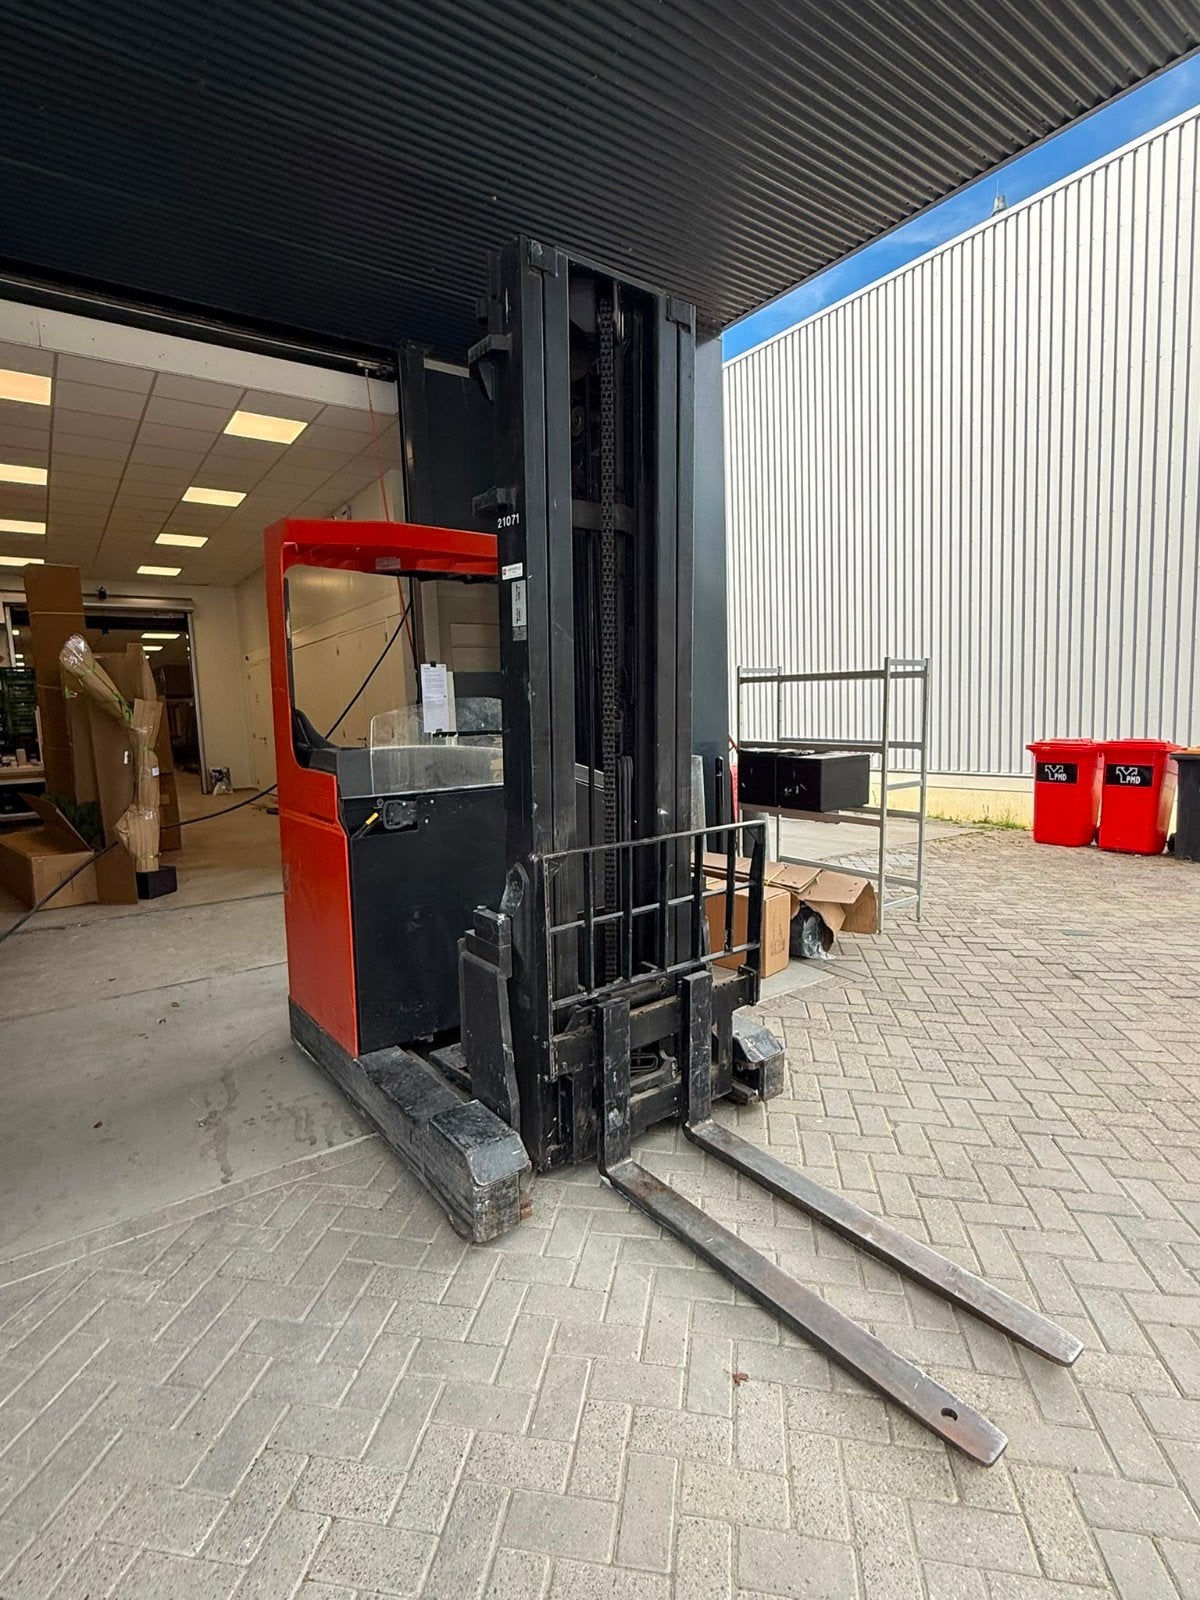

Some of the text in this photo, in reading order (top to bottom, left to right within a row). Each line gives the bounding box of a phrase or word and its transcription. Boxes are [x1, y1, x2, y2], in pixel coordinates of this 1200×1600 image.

[497, 513, 520, 529] 21071
[1054, 773, 1067, 782] PMD
[1126, 775, 1141, 785] PMD
